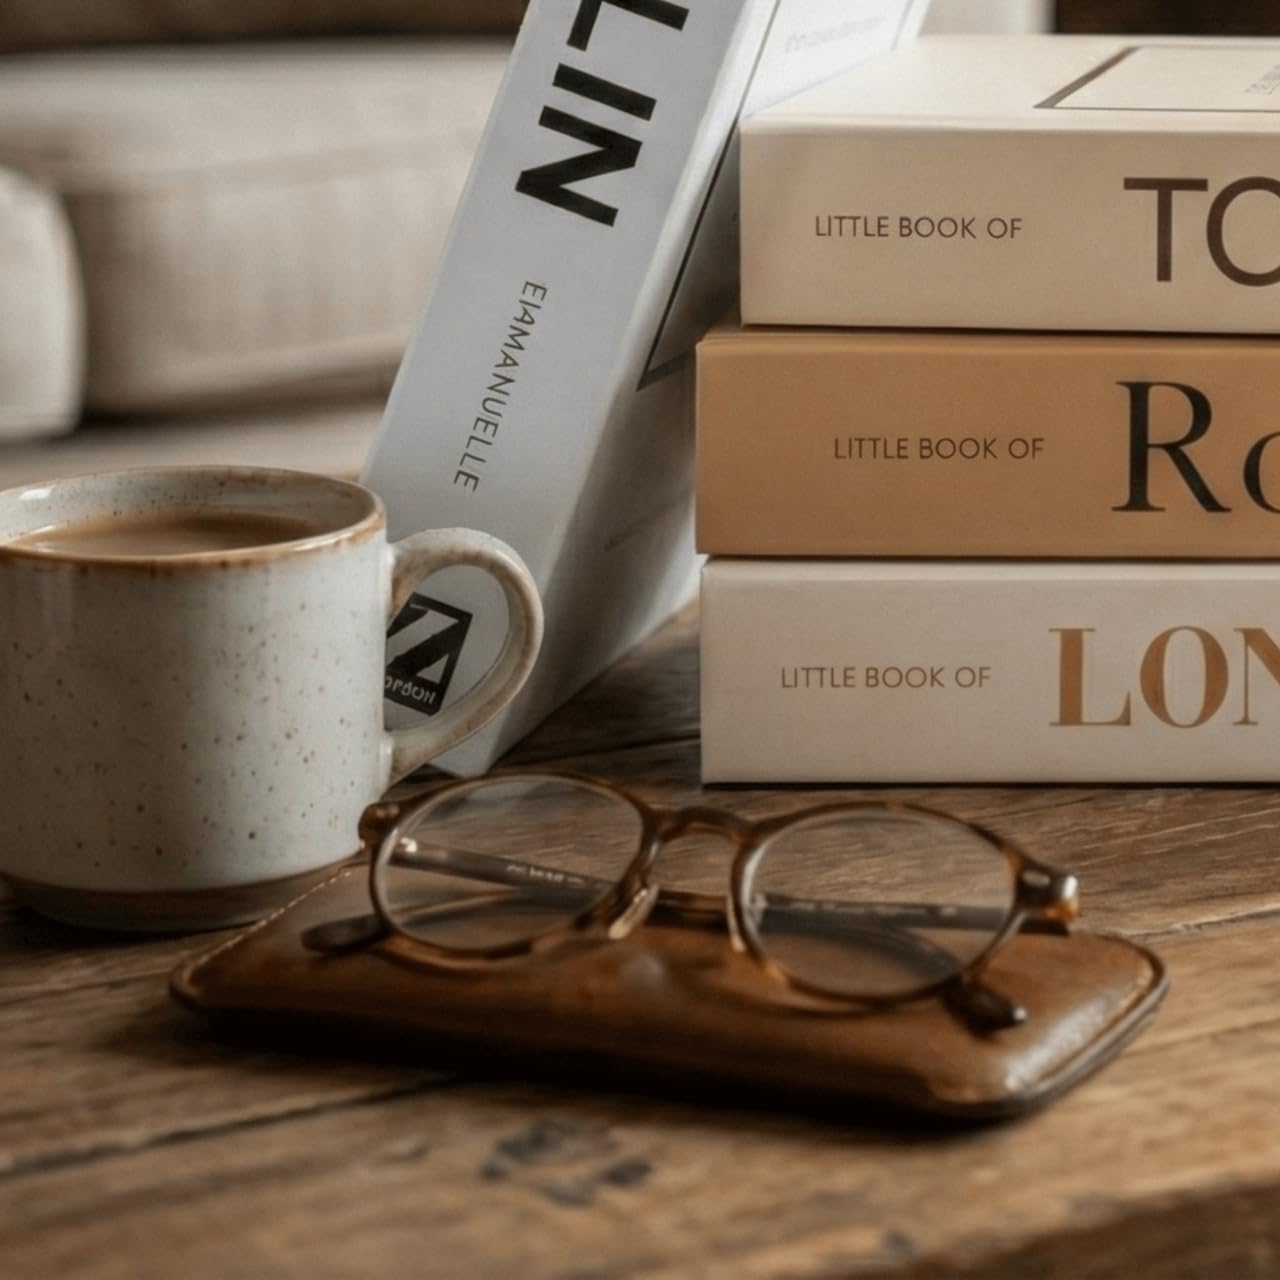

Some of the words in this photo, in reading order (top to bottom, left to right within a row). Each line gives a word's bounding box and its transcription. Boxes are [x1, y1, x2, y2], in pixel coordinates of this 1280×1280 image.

[815, 215, 889, 238] LITTLE
[899, 216, 977, 239] BOOK
[986, 217, 1022, 240] OF
[834, 437, 909, 460] LITTLE
[919, 437, 998, 460] BOOK
[1007, 437, 1045, 460] OF
[781, 666, 856, 689] LITTLE
[865, 666, 945, 689] BOOK
[954, 666, 991, 689] OF
